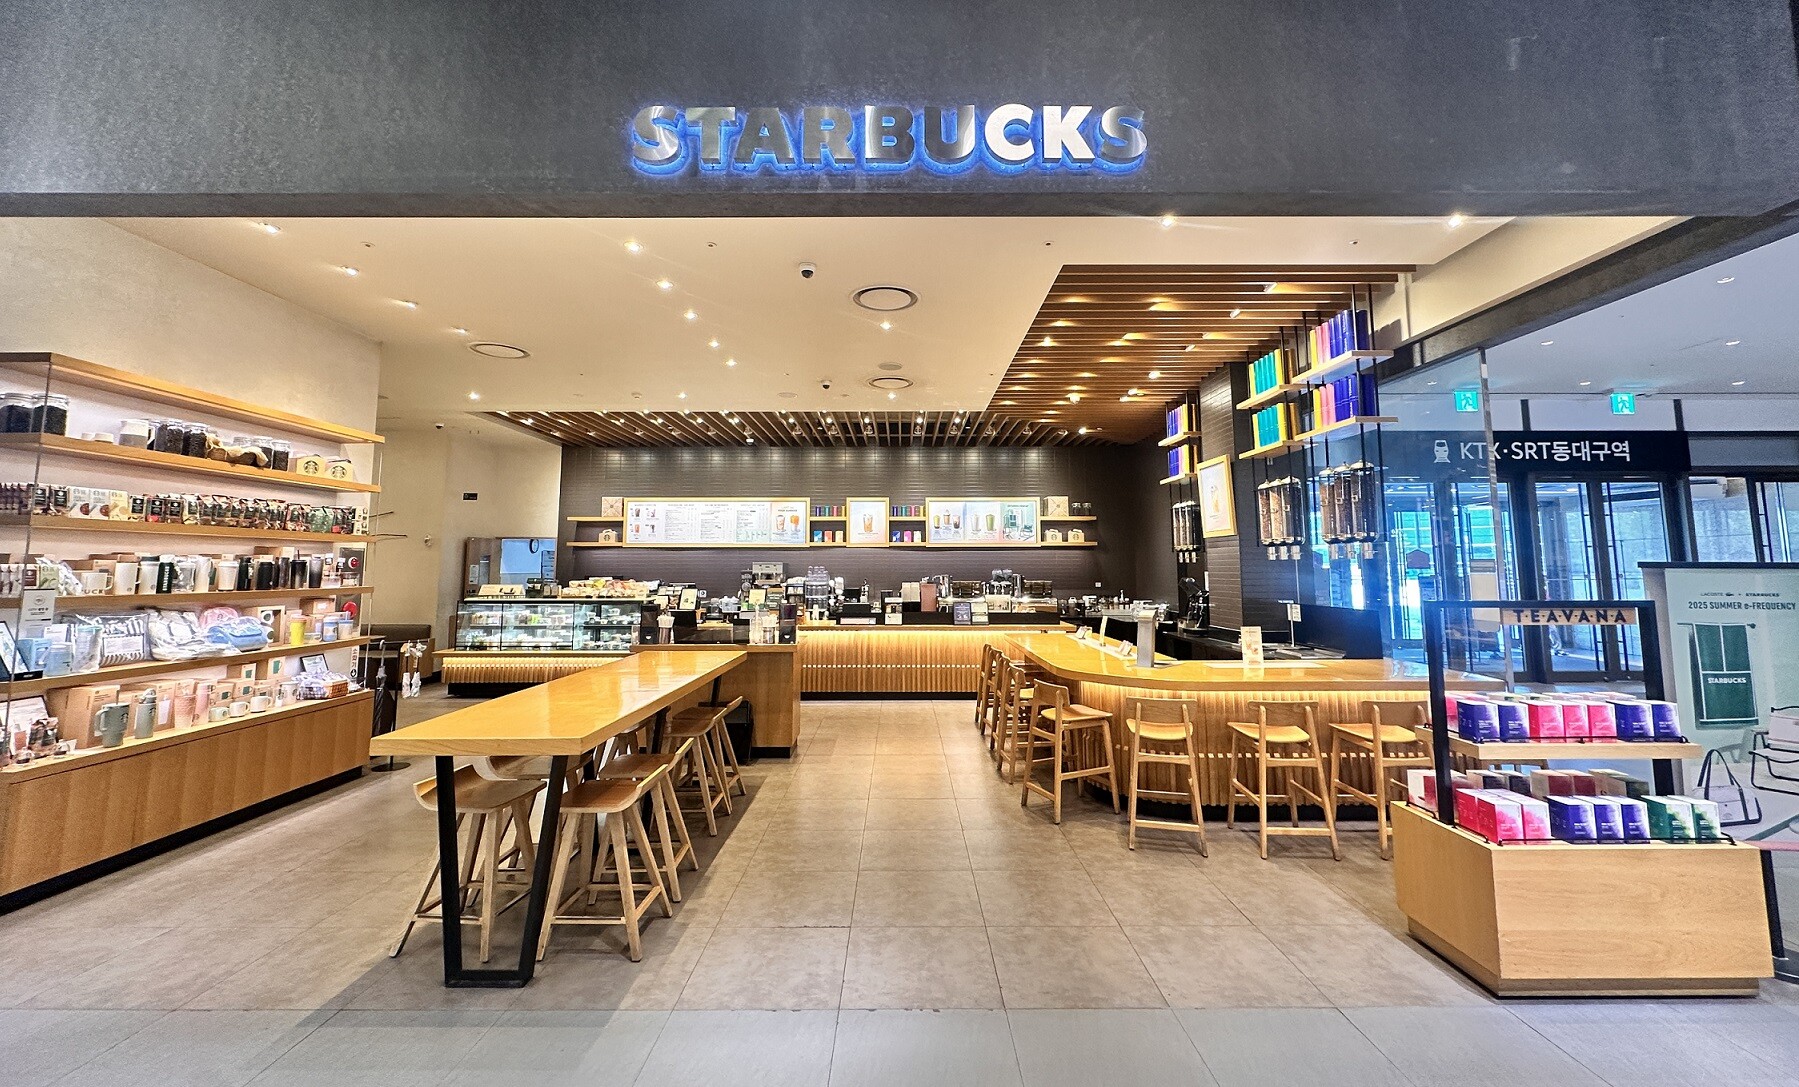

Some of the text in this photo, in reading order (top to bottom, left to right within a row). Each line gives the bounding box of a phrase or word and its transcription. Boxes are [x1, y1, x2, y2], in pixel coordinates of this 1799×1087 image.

[633, 103, 1148, 168] STARBUCKS
[1688, 601, 1796, 611] 2025 SUMMER e-FREQUENCY
